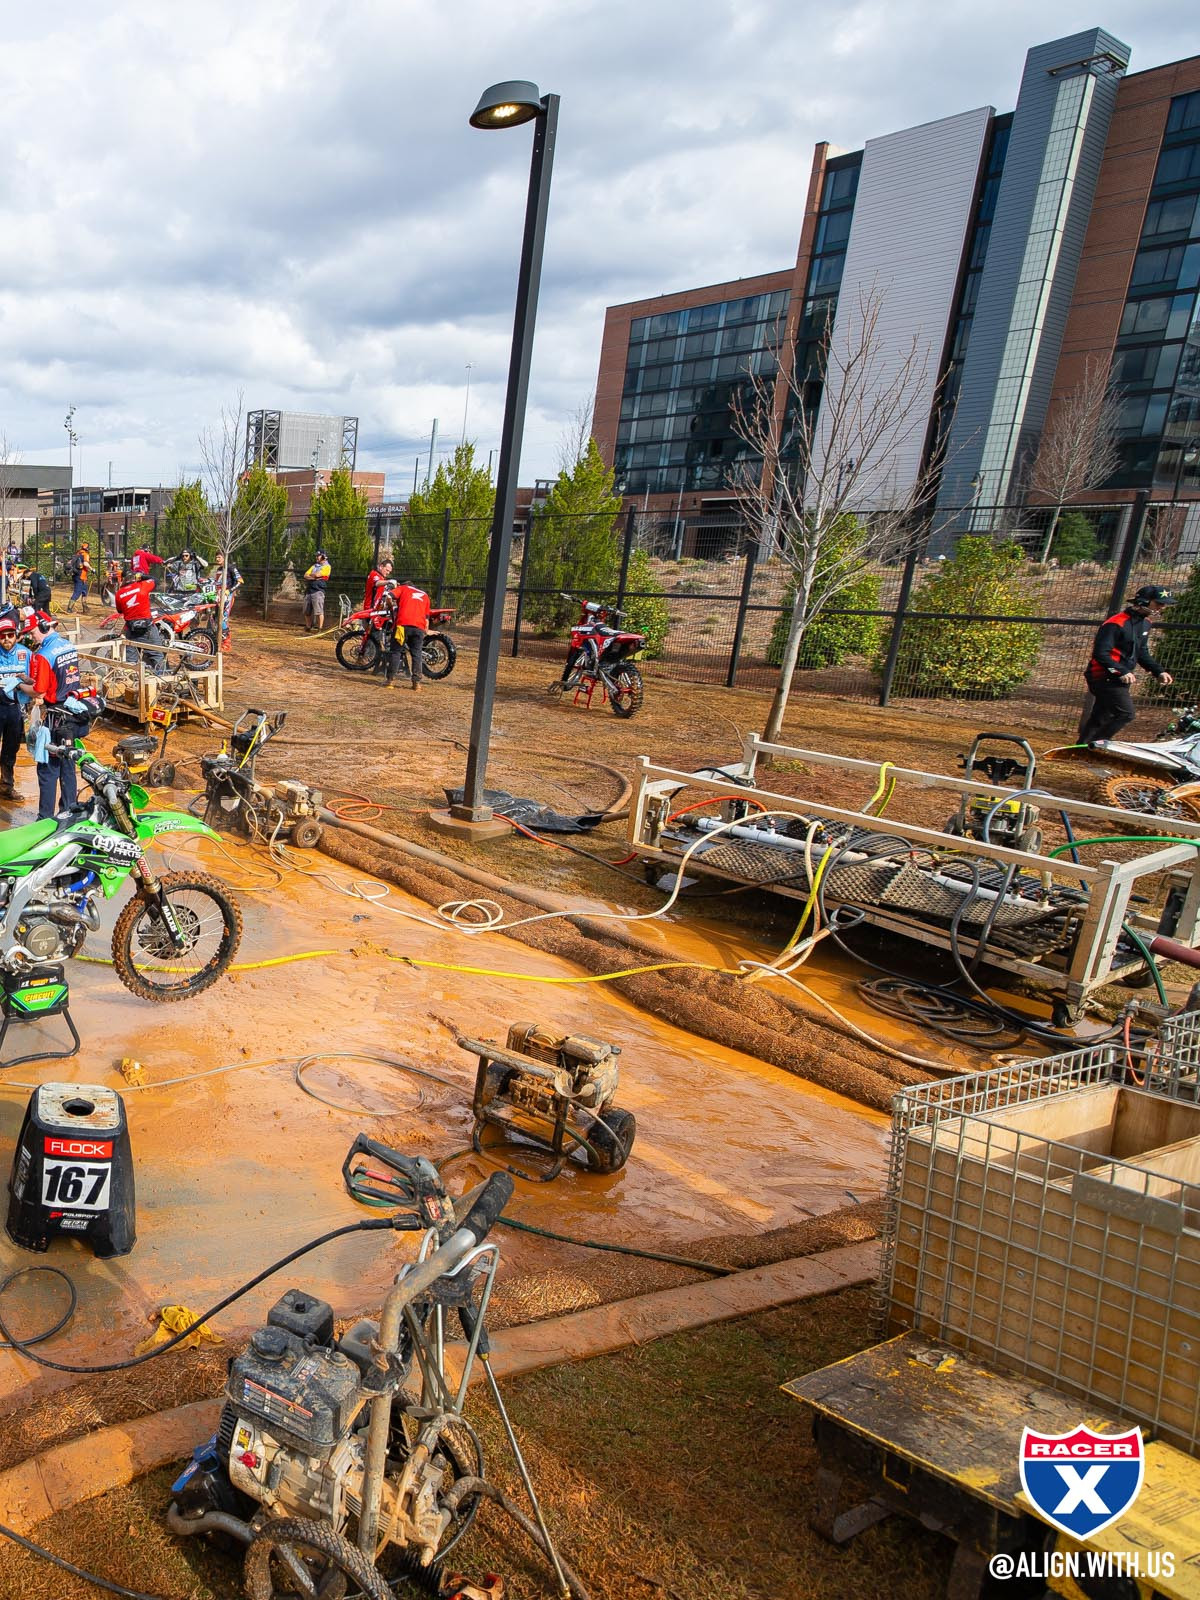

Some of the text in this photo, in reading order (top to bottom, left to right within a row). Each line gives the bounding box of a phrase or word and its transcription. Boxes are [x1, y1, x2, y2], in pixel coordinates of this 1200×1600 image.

[25, 990, 56, 1003] CIRCUIT
[51, 1141, 105, 1155] FLOCK
[45, 1165, 110, 1205] 167
